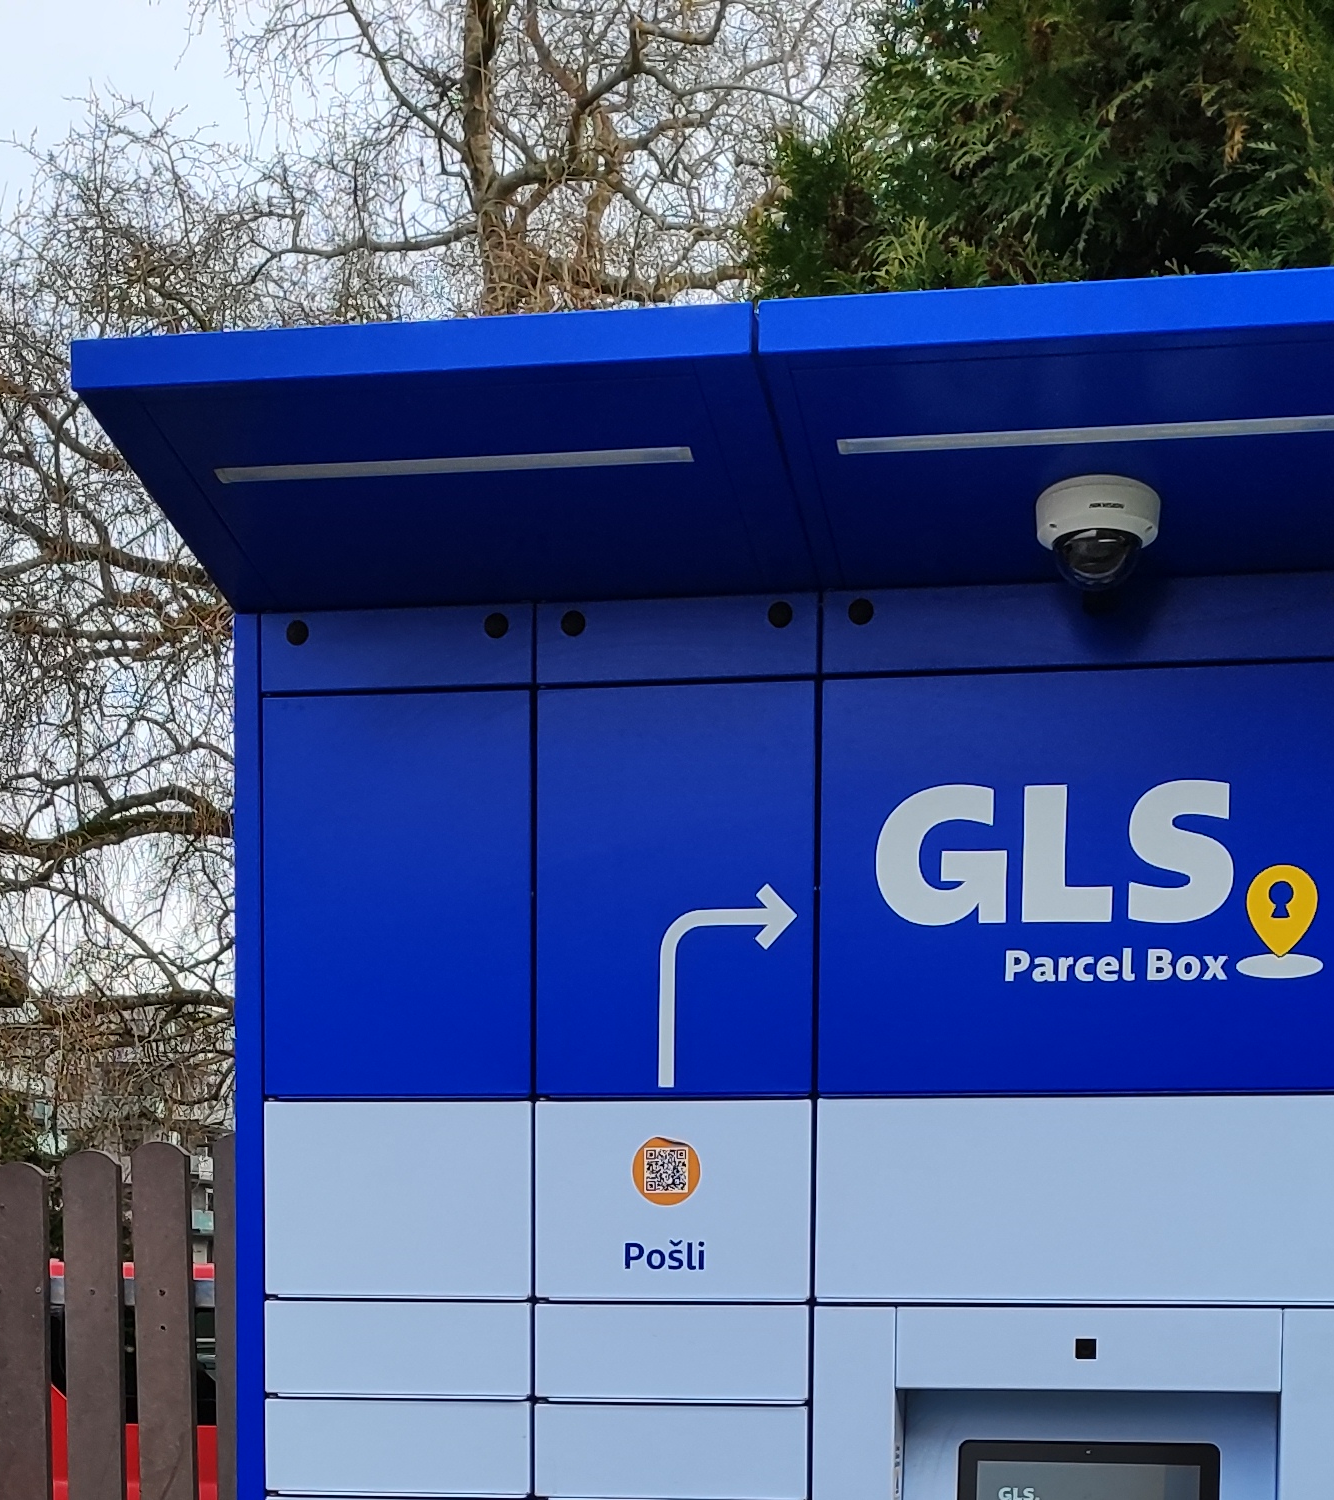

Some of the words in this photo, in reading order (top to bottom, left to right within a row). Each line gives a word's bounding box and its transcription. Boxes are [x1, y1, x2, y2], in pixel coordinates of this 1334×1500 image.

[875, 780, 1234, 926] GLS
[1004, 947, 1135, 983] Parcel
[1146, 948, 1229, 981] Box
[624, 1239, 705, 1270] Pošli
